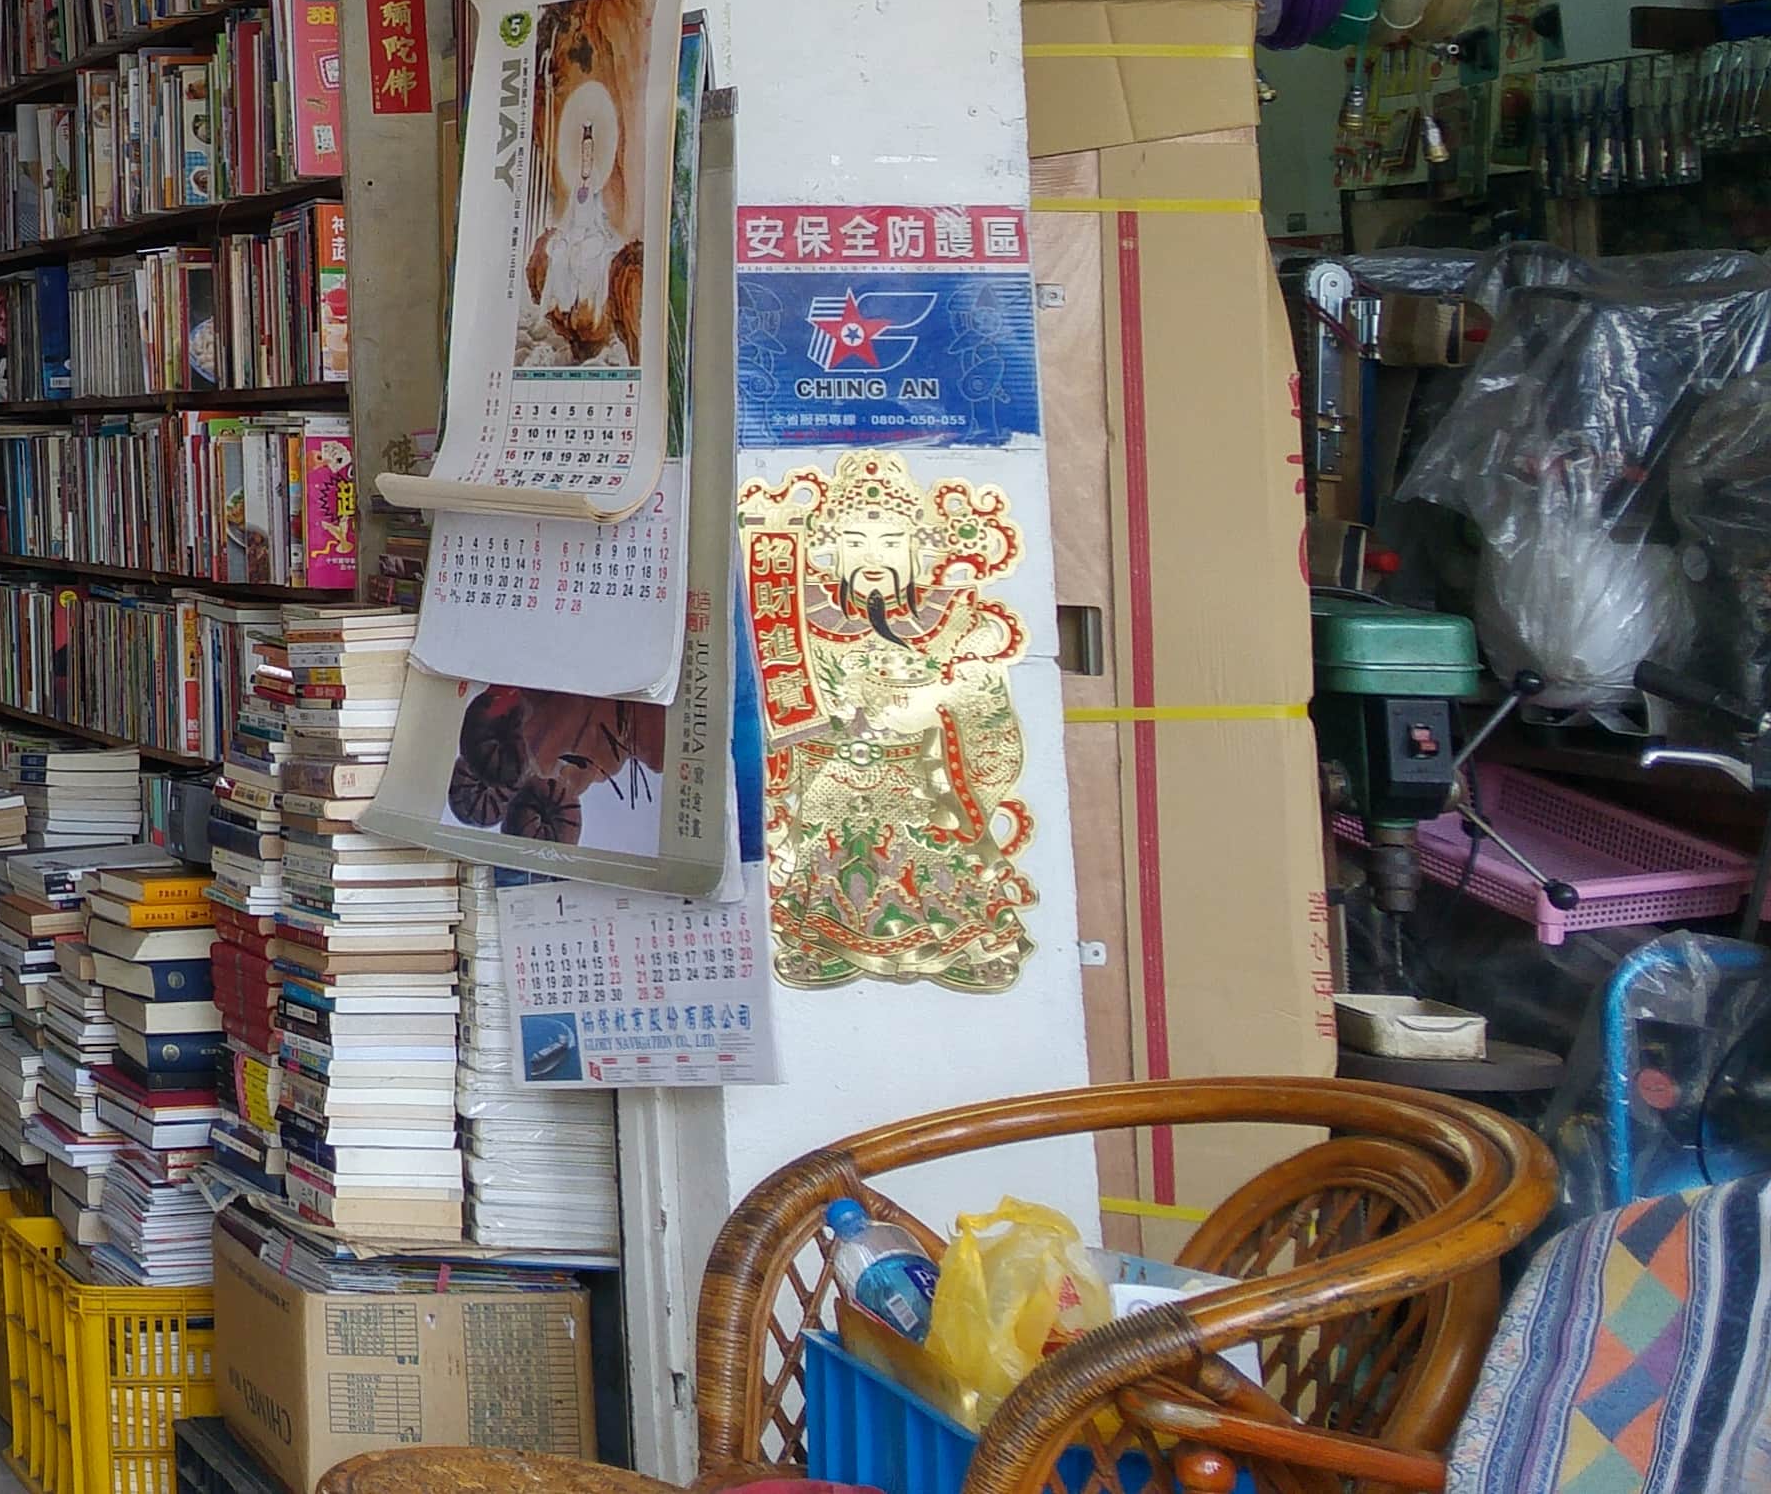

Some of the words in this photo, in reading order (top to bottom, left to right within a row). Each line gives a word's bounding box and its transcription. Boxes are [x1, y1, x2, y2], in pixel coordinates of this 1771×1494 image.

[493, 57, 523, 194] MAY
[795, 378, 887, 400] CHING
[899, 378, 940, 400] AN
[512, 428, 518, 438] 9
[528, 429, 539, 438] 10
[546, 429, 556, 439] 11
[565, 429, 576, 439] 12
[583, 430, 594, 440] 13
[602, 430, 613, 440] 14
[621, 431, 633, 441] 15
[505, 451, 516, 460] 16
[523, 451, 535, 461] 17
[541, 452, 552, 461] 18
[560, 452, 572, 462] 19
[578, 453, 591, 463] 20
[597, 453, 610, 463] 21
[615, 454, 629, 464] 22
[653, 492, 664, 513] 2
[691, 640, 710, 754] JUANHUA
